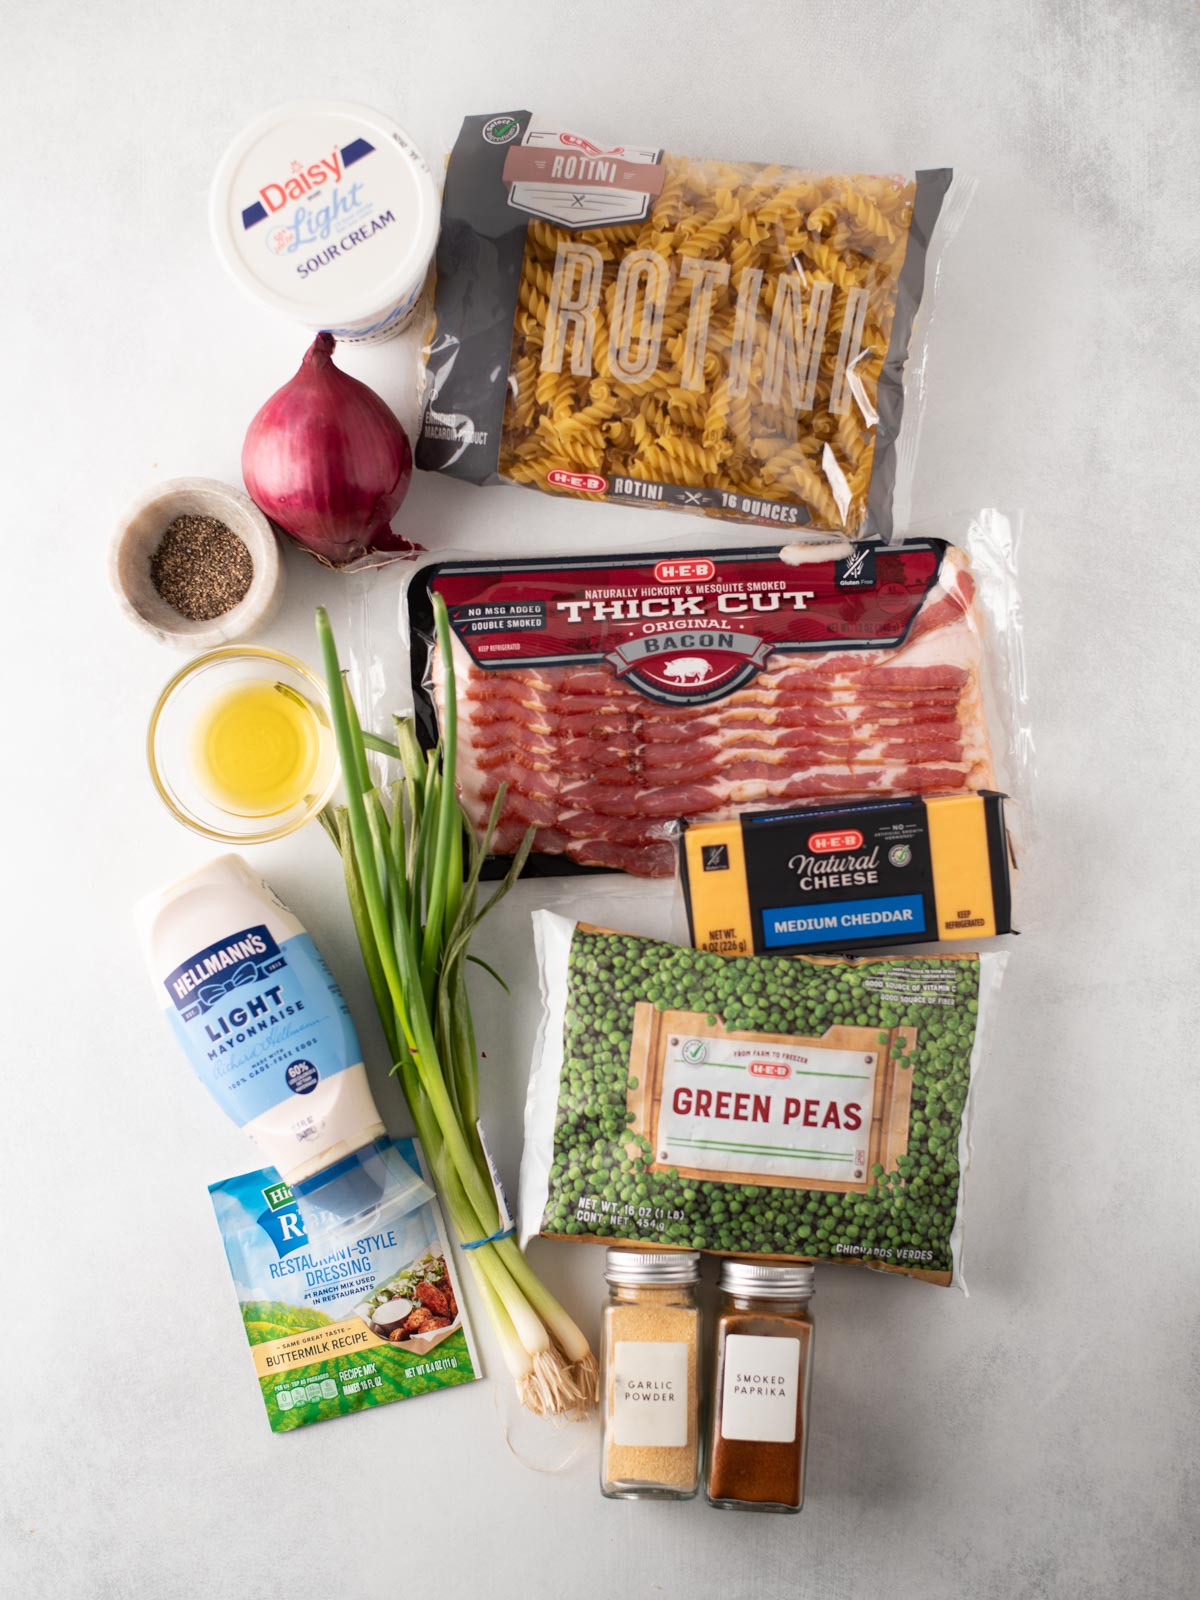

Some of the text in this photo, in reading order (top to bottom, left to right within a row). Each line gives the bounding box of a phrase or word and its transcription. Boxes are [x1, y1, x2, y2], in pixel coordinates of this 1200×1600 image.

[551, 155, 617, 184] ROTINI
[259, 152, 342, 213] Daisy
[287, 182, 364, 254] Light
[297, 245, 341, 279] SOUR
[340, 210, 396, 251] CREAM
[540, 242, 870, 415] ROTINI
[615, 478, 663, 500] ROTINI
[722, 492, 738, 508] 16
[742, 499, 799, 523] OUNCES
[585, 581, 786, 600] NATURALLY HICKORY & MESQUITE SMOKED
[468, 605, 541, 617] NO MSG ADDED
[557, 591, 815, 623] THICK CUT
[471, 619, 542, 631] DOUBLE SMOKED
[642, 619, 731, 634] ORIGINAL
[644, 633, 734, 653] BACON
[788, 846, 880, 877] Natural
[800, 871, 878, 891] CHEESE
[774, 909, 913, 933] MEDIUM CHEDDAR
[945, 919, 985, 930] REFRIGERATED
[957, 910, 971, 919] KEEP
[709, 930, 722, 940] NET
[172, 933, 267, 1000] HELLMANN'S
[204, 985, 284, 1042] LIGHT
[207, 1001, 304, 1061] MAYONNAISE
[249, 1051, 293, 1079] CAGE-FREE
[295, 1038, 318, 1053] EGGS
[251, 1048, 285, 1069] MADE WITH
[782, 1053, 808, 1064] FREEZER
[288, 1062, 309, 1078] 60%
[672, 1087, 862, 1131] GREEN PEAS
[578, 1197, 597, 1210] NET
[601, 1200, 621, 1214] WT.
[624, 1204, 635, 1215] 16
[638, 1206, 652, 1217] OZ
[576, 1210, 607, 1224] CONT.
[636, 1218, 656, 1228] 454
[896, 1249, 934, 1260] VERDES
[306, 1257, 371, 1287] DRESSING
[313, 1285, 339, 1299] RANCH
[340, 1281, 354, 1292] MIX
[355, 1276, 376, 1288] USED
[313, 1284, 375, 1305] IN RESTAURANTS
[282, 1328, 345, 1350] SAME GREAT TASTE
[266, 1332, 368, 1367] BUTTERMILK RECIPE
[339, 1362, 377, 1382] RECIPE MIX
[404, 1368, 415, 1379] NET
[736, 1373, 785, 1385] SMOKED
[342, 1383, 360, 1396] MAKES
[627, 1380, 673, 1390] GARLIC
[734, 1386, 786, 1397] PAPRIKA
[624, 1392, 675, 1402] POWDER
